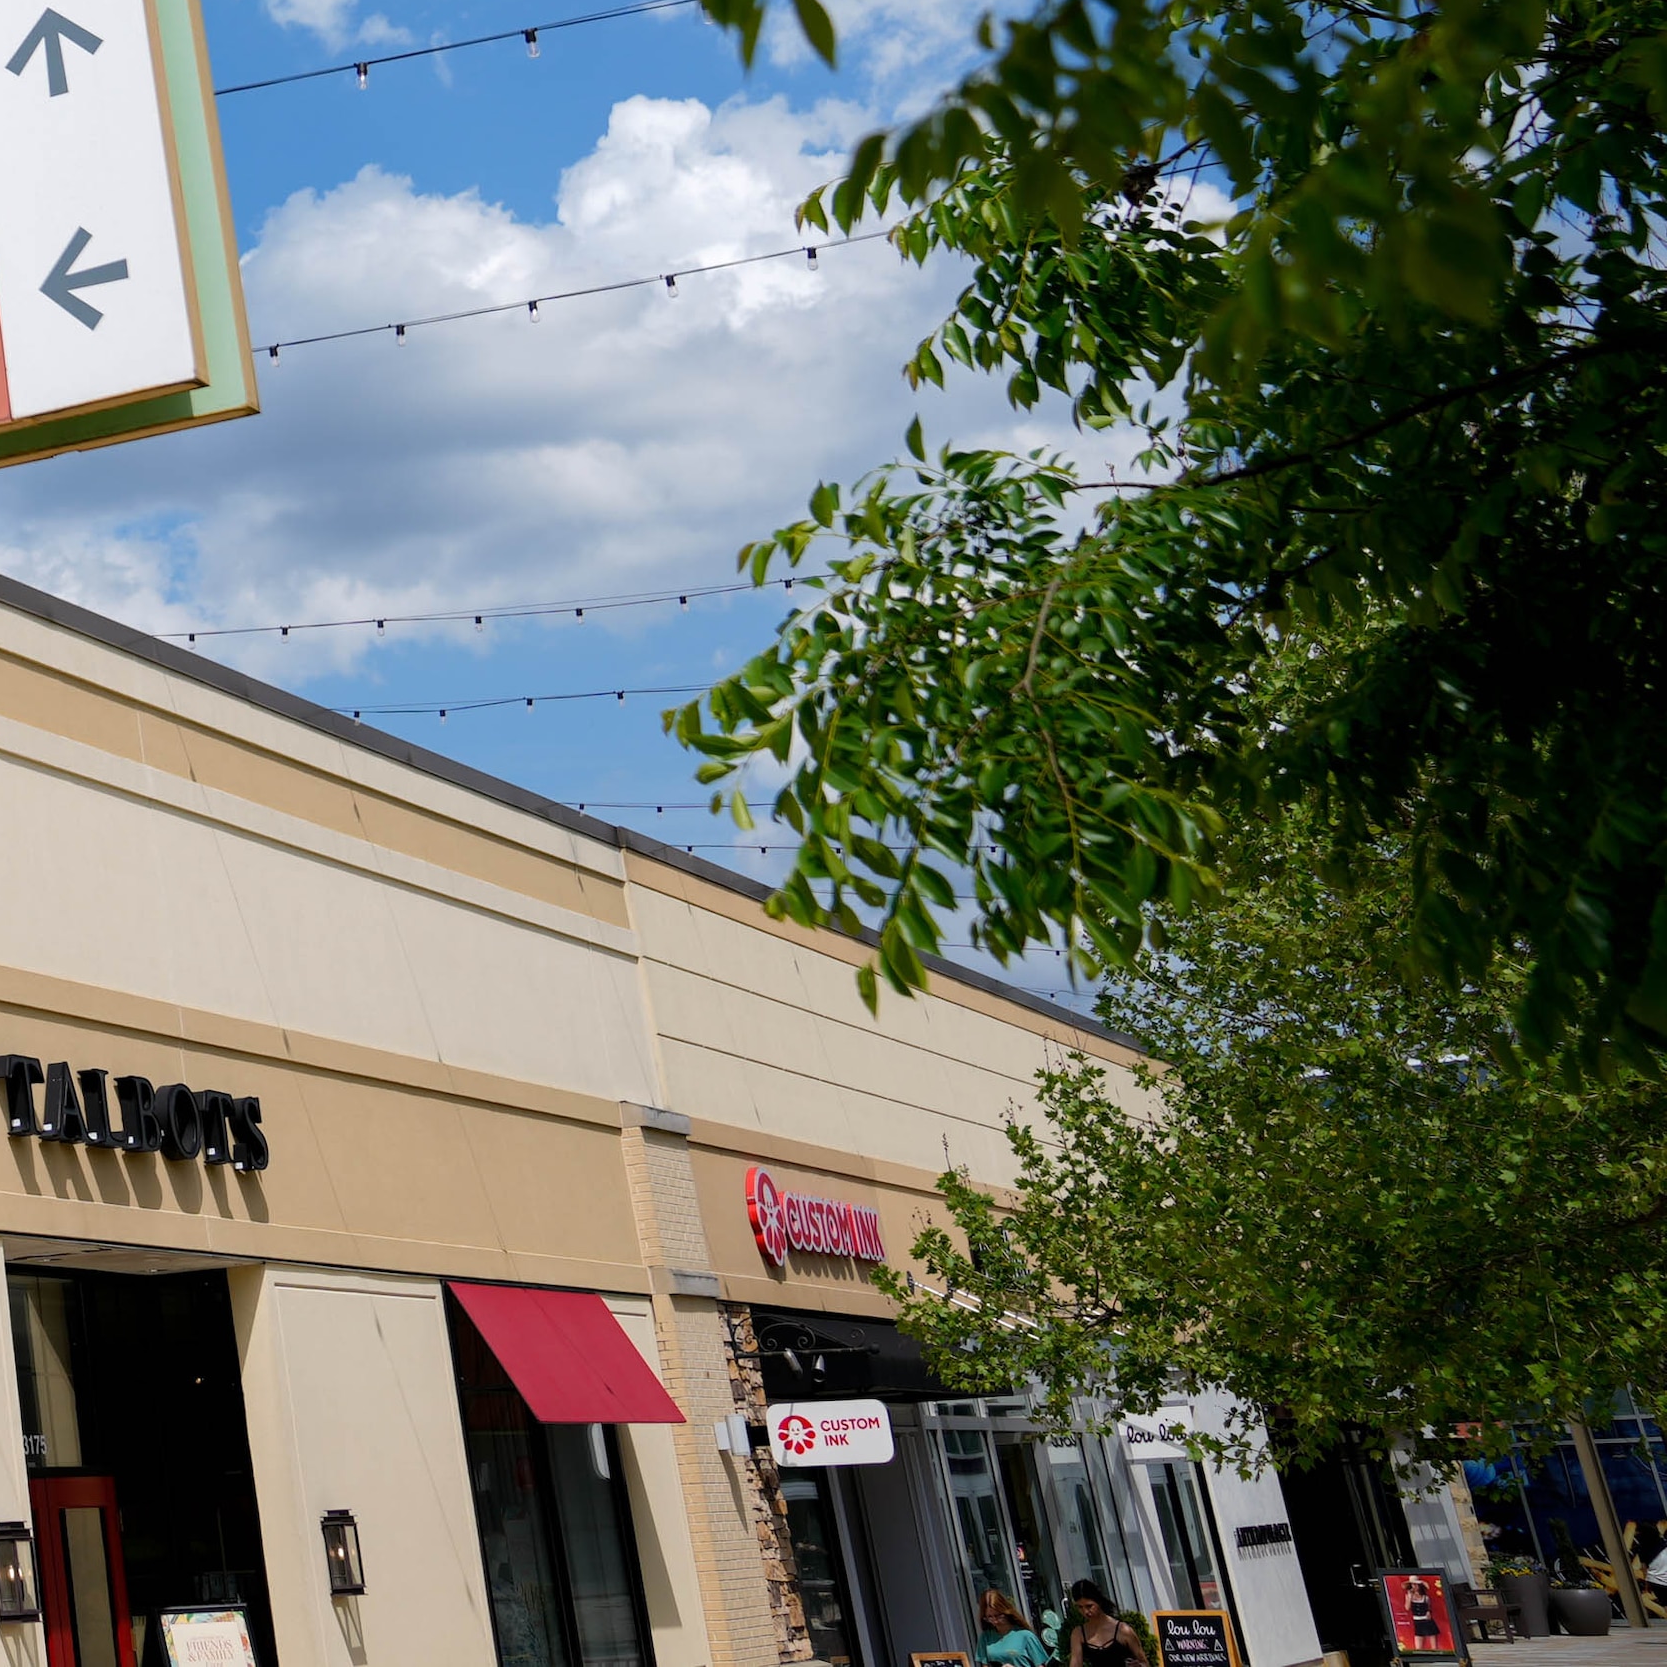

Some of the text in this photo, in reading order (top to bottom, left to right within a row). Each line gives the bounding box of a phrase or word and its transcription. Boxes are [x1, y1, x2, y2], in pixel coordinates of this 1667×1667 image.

[781, 1191, 887, 1263] CUSTOM INK
[820, 1417, 880, 1432] CUSTOM
[824, 1434, 850, 1447] INK
[1127, 1425, 1155, 1444] lou
[23, 1434, 48, 1455] 3175
[1167, 1619, 1216, 1636] lou lou
